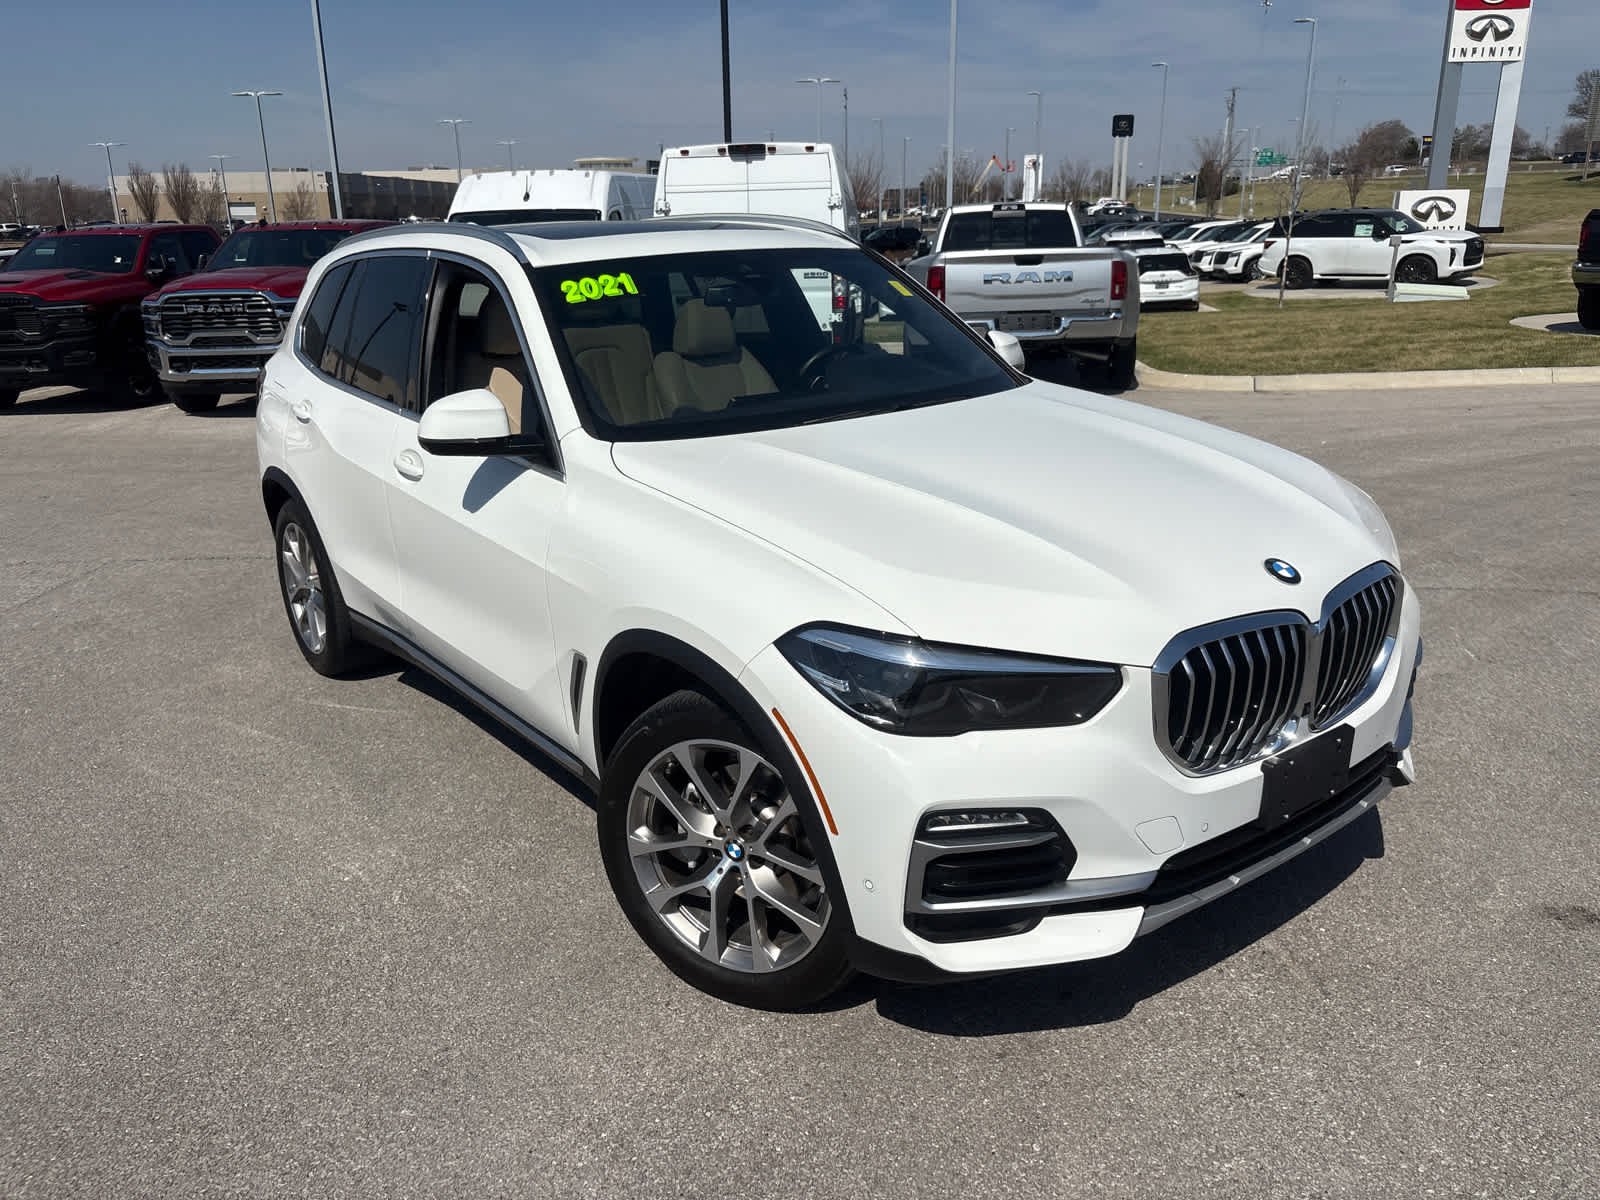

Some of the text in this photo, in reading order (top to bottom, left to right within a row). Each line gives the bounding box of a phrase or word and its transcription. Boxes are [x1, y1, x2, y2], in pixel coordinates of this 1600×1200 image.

[1452, 46, 1521, 58] INFINITI
[983, 270, 1073, 284] RAM
[561, 272, 639, 303] 2021
[184, 303, 245, 313] RAM
